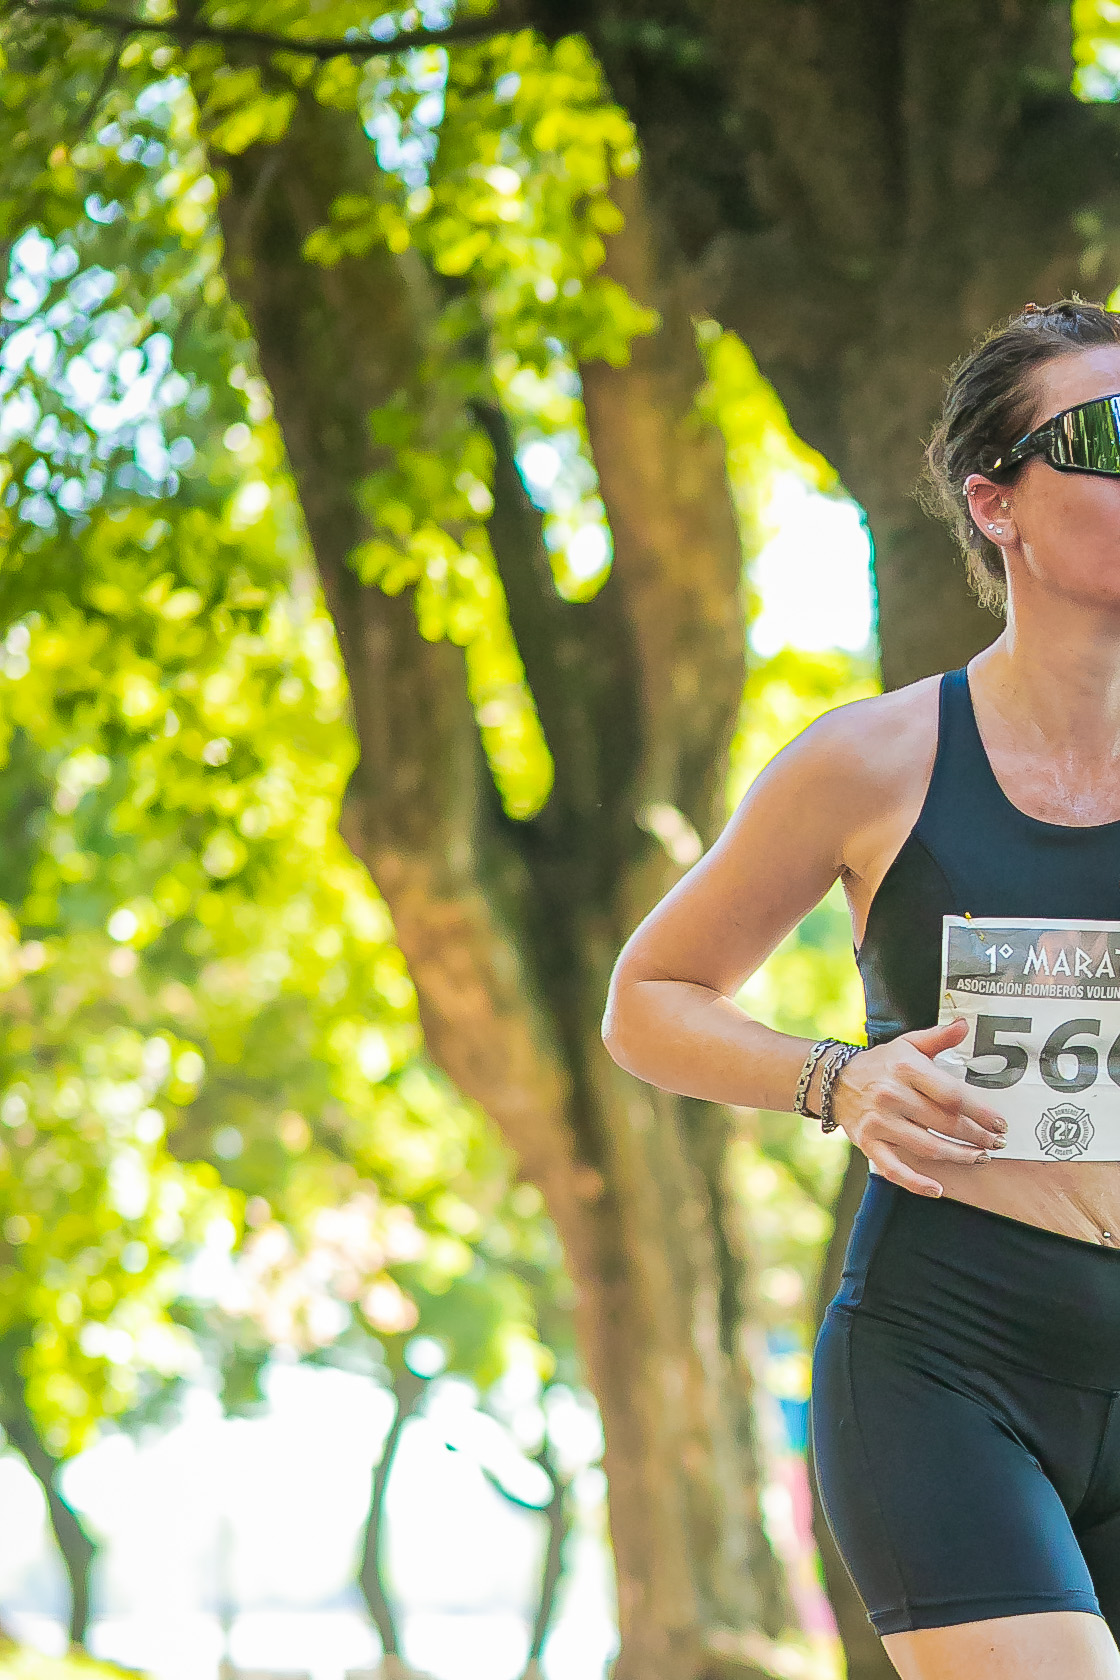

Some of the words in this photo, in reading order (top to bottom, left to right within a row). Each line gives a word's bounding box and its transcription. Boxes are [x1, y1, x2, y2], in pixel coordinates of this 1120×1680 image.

[956, 978, 1023, 995] ASOCIACIÓN
[1025, 984, 1084, 998] BOMBEROS
[1053, 1120, 1078, 1141] 27
